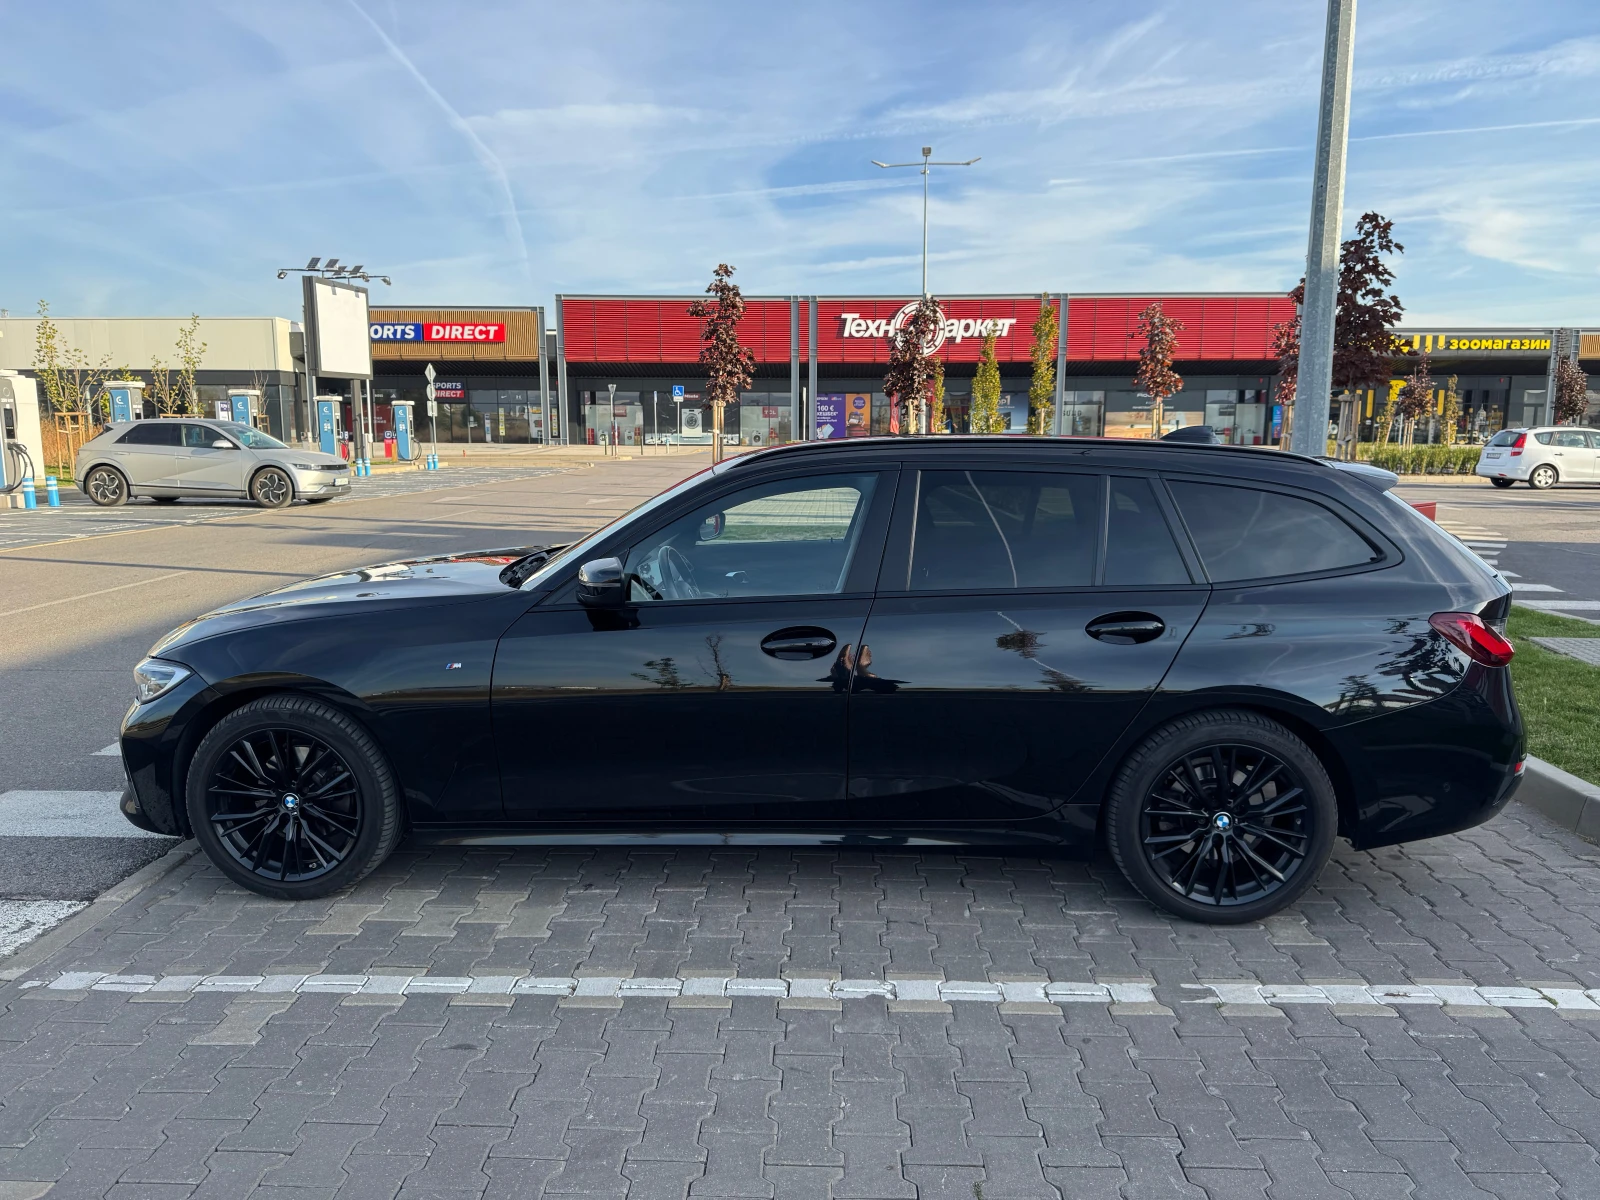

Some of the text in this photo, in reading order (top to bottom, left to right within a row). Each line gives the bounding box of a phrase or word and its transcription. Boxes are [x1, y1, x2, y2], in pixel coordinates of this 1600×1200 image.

[369, 325, 498, 339] ORTS DIRECT
[1449, 338, 1551, 350] зоомагазин
[435, 390, 462, 398] IRECT
